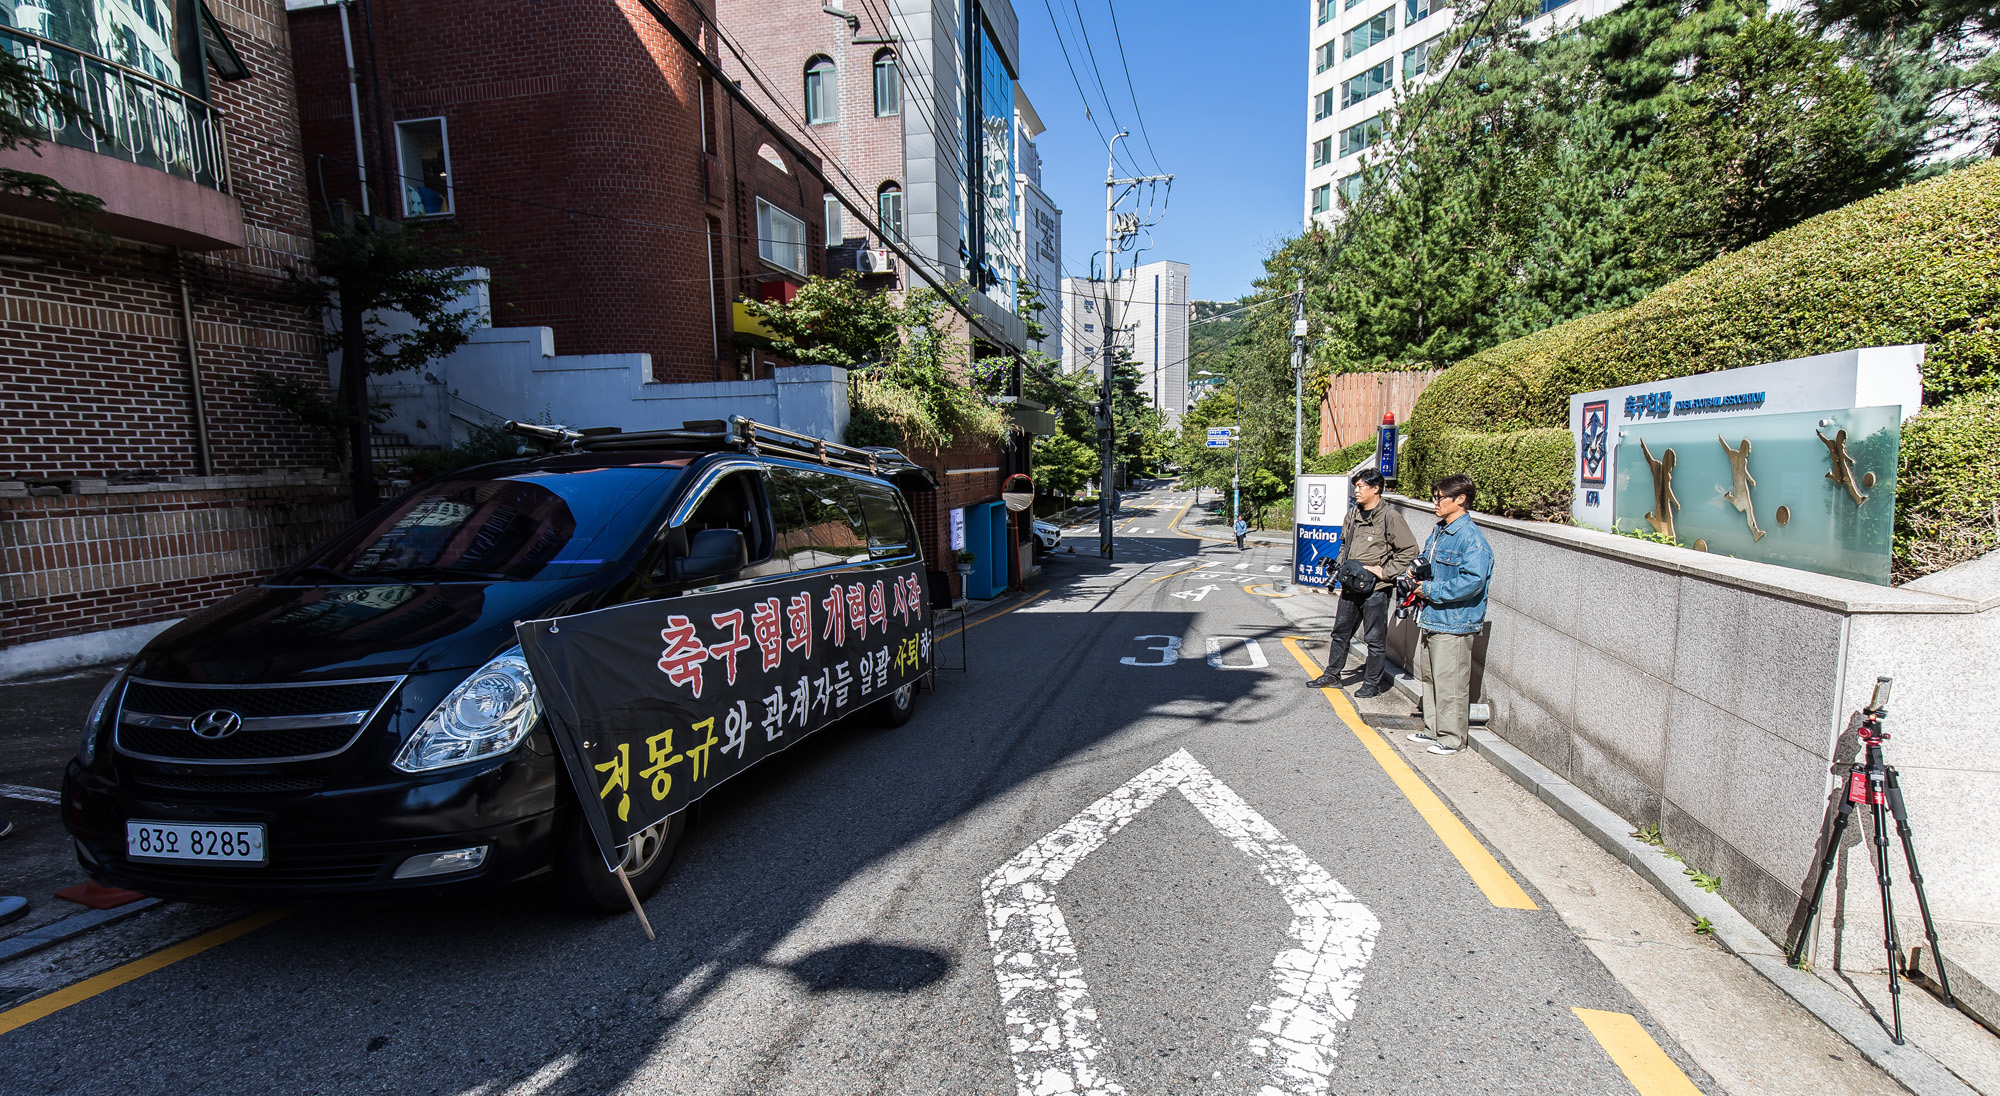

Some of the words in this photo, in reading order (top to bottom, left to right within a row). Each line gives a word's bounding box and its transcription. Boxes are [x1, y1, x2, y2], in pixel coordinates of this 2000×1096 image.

[1625, 390, 1672, 415] 축구회관
[1586, 490, 1600, 506] KFA
[1299, 528, 1338, 543] Parking
[1298, 575, 1309, 583] KFA
[658, 591, 813, 698] 축구협회
[822, 580, 888, 648] 개혁의
[893, 572, 922, 627] 시작
[1119, 634, 1270, 669] 30
[594, 700, 752, 822] 정몽규와
[760, 660, 853, 743] 관계자들
[859, 645, 891, 695] 일괄
[893, 627, 932, 678] 사퇴하
[138, 826, 180, 854] 83오
[190, 830, 251, 857] 8285
